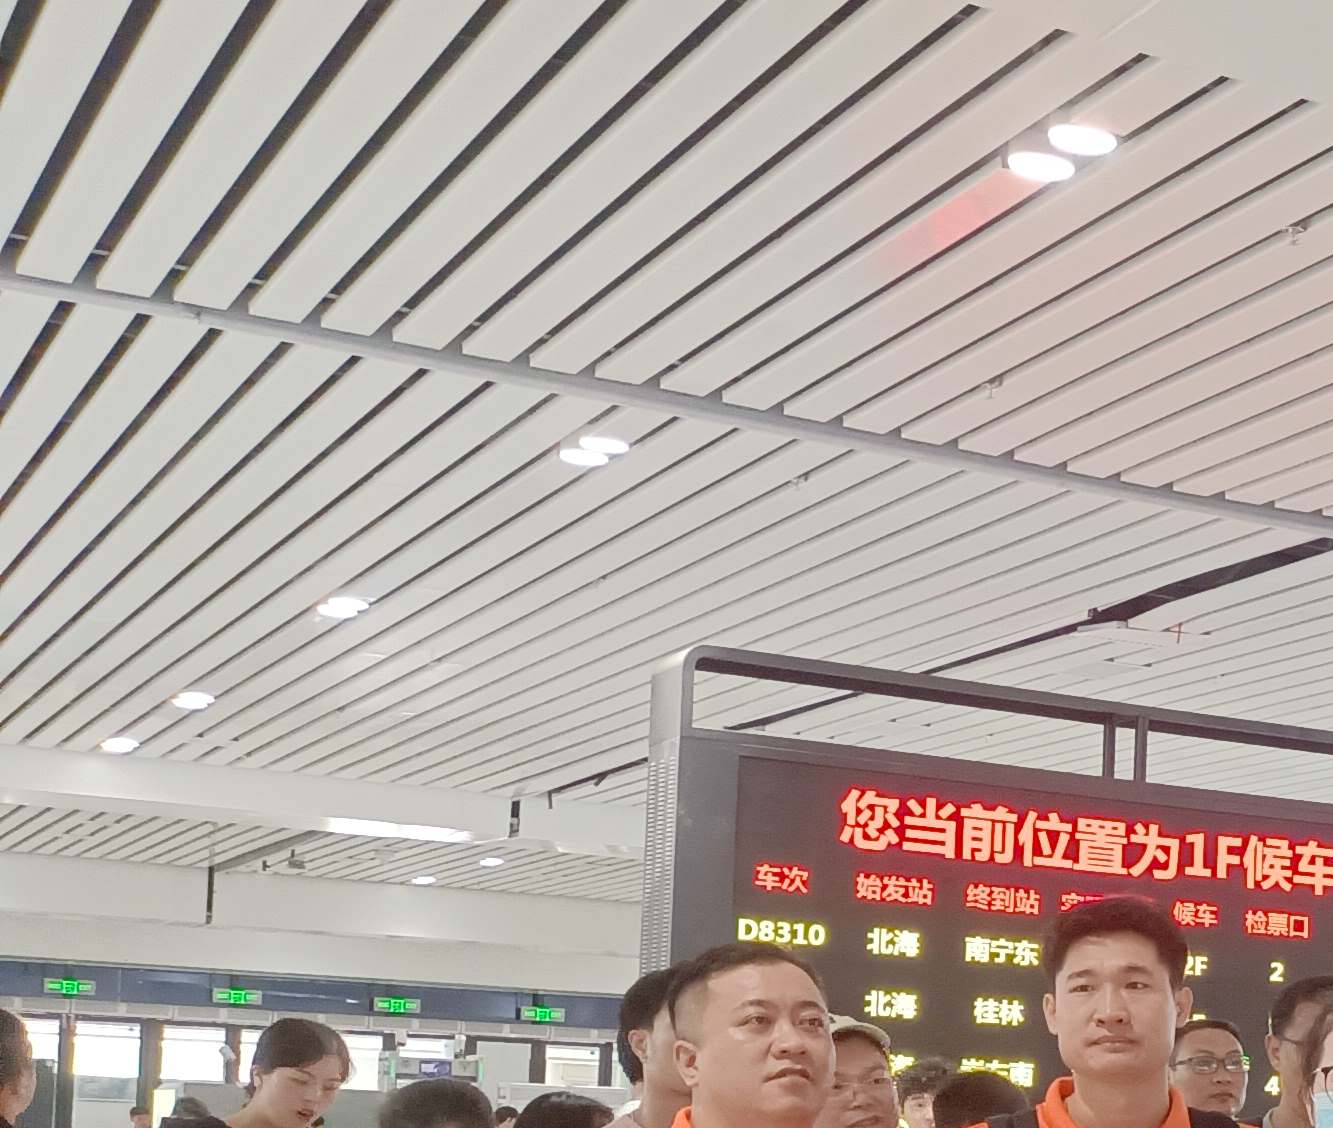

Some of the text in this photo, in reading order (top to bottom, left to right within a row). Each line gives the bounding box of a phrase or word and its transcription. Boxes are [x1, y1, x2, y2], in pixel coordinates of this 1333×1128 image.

[754, 863, 810, 894] 车次
[855, 872, 934, 906] 始发站
[964, 883, 1041, 916] 终到站
[1172, 900, 1218, 928] 候车
[1244, 910, 1310, 939] 检票口
[737, 917, 826, 947] D8310
[866, 927, 921, 958] 北海
[964, 935, 1041, 966] 南宁东
[1268, 961, 1285, 983] 2
[864, 989, 1025, 1026] 北海 桂林
